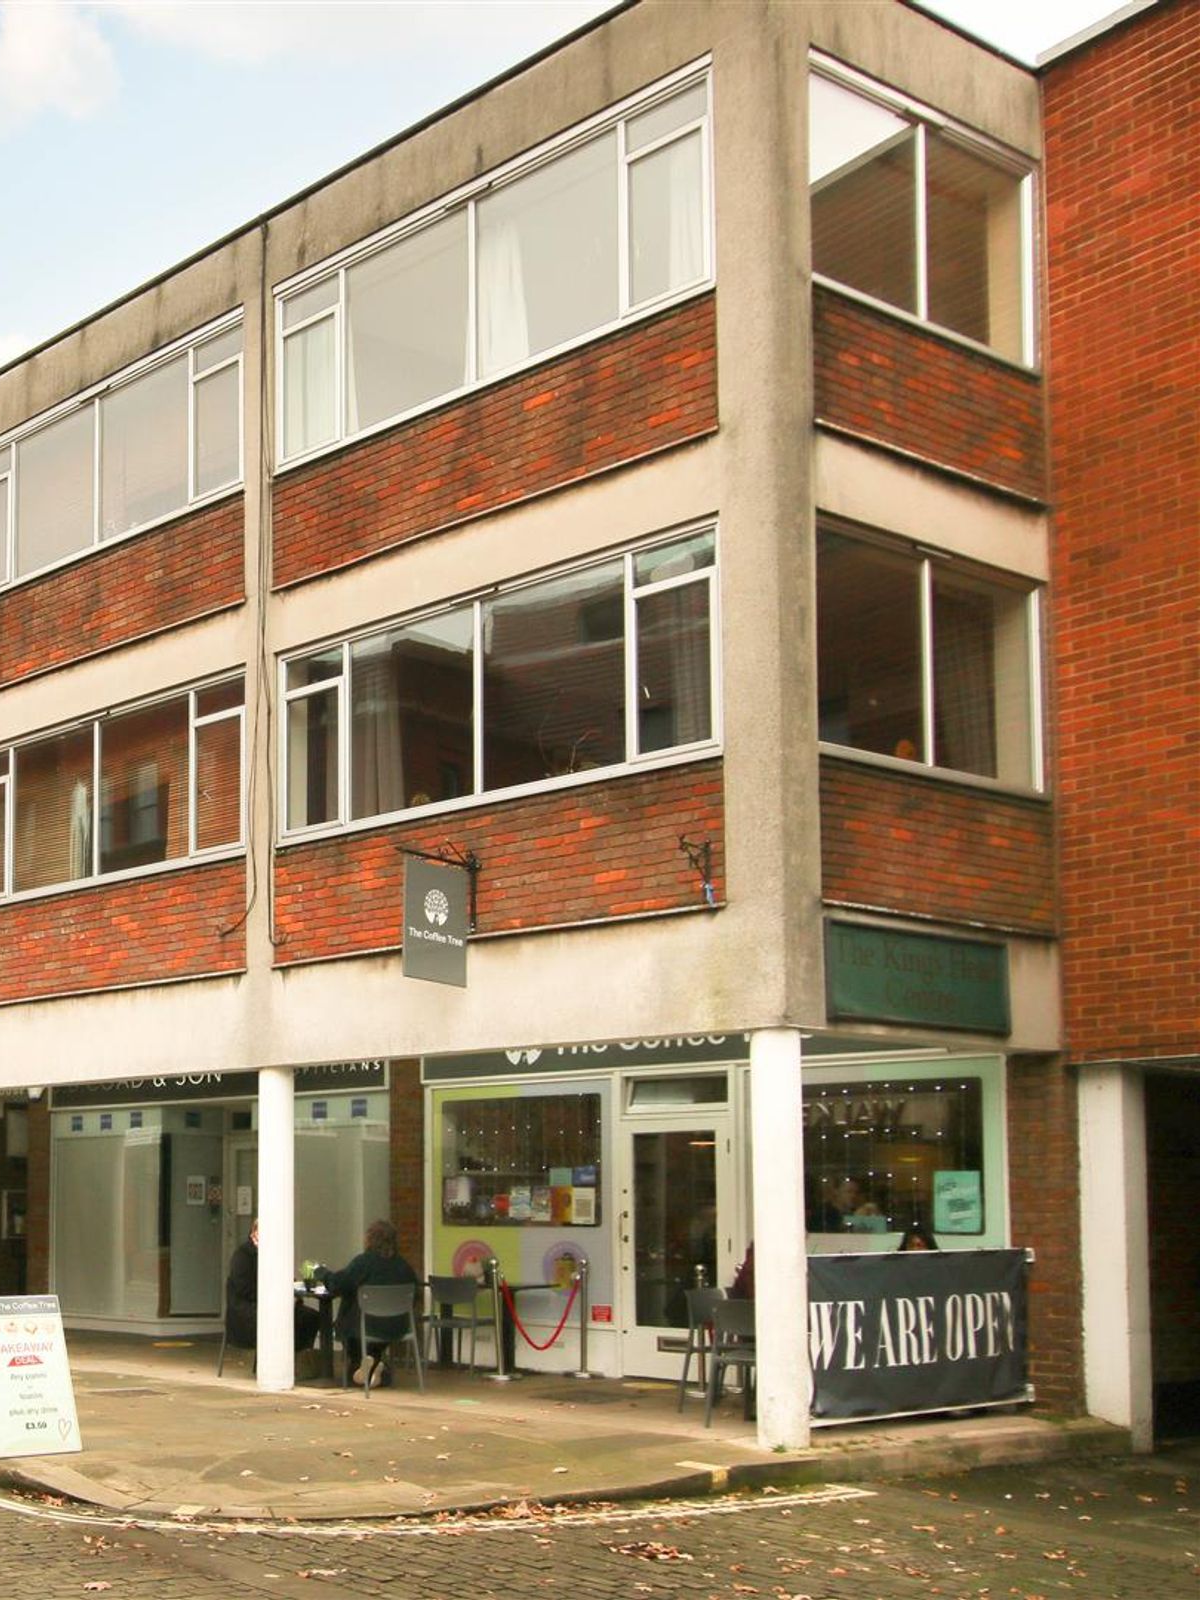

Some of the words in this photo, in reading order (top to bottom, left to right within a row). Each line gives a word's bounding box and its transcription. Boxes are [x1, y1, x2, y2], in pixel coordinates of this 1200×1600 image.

[409, 926, 422, 938] The
[423, 930, 446, 943] Coffee
[447, 934, 463, 947] Tree
[834, 934, 875, 968] The
[152, 1075, 167, 1088] &
[807, 1300, 866, 1371] WE
[872, 1296, 938, 1369] ARE
